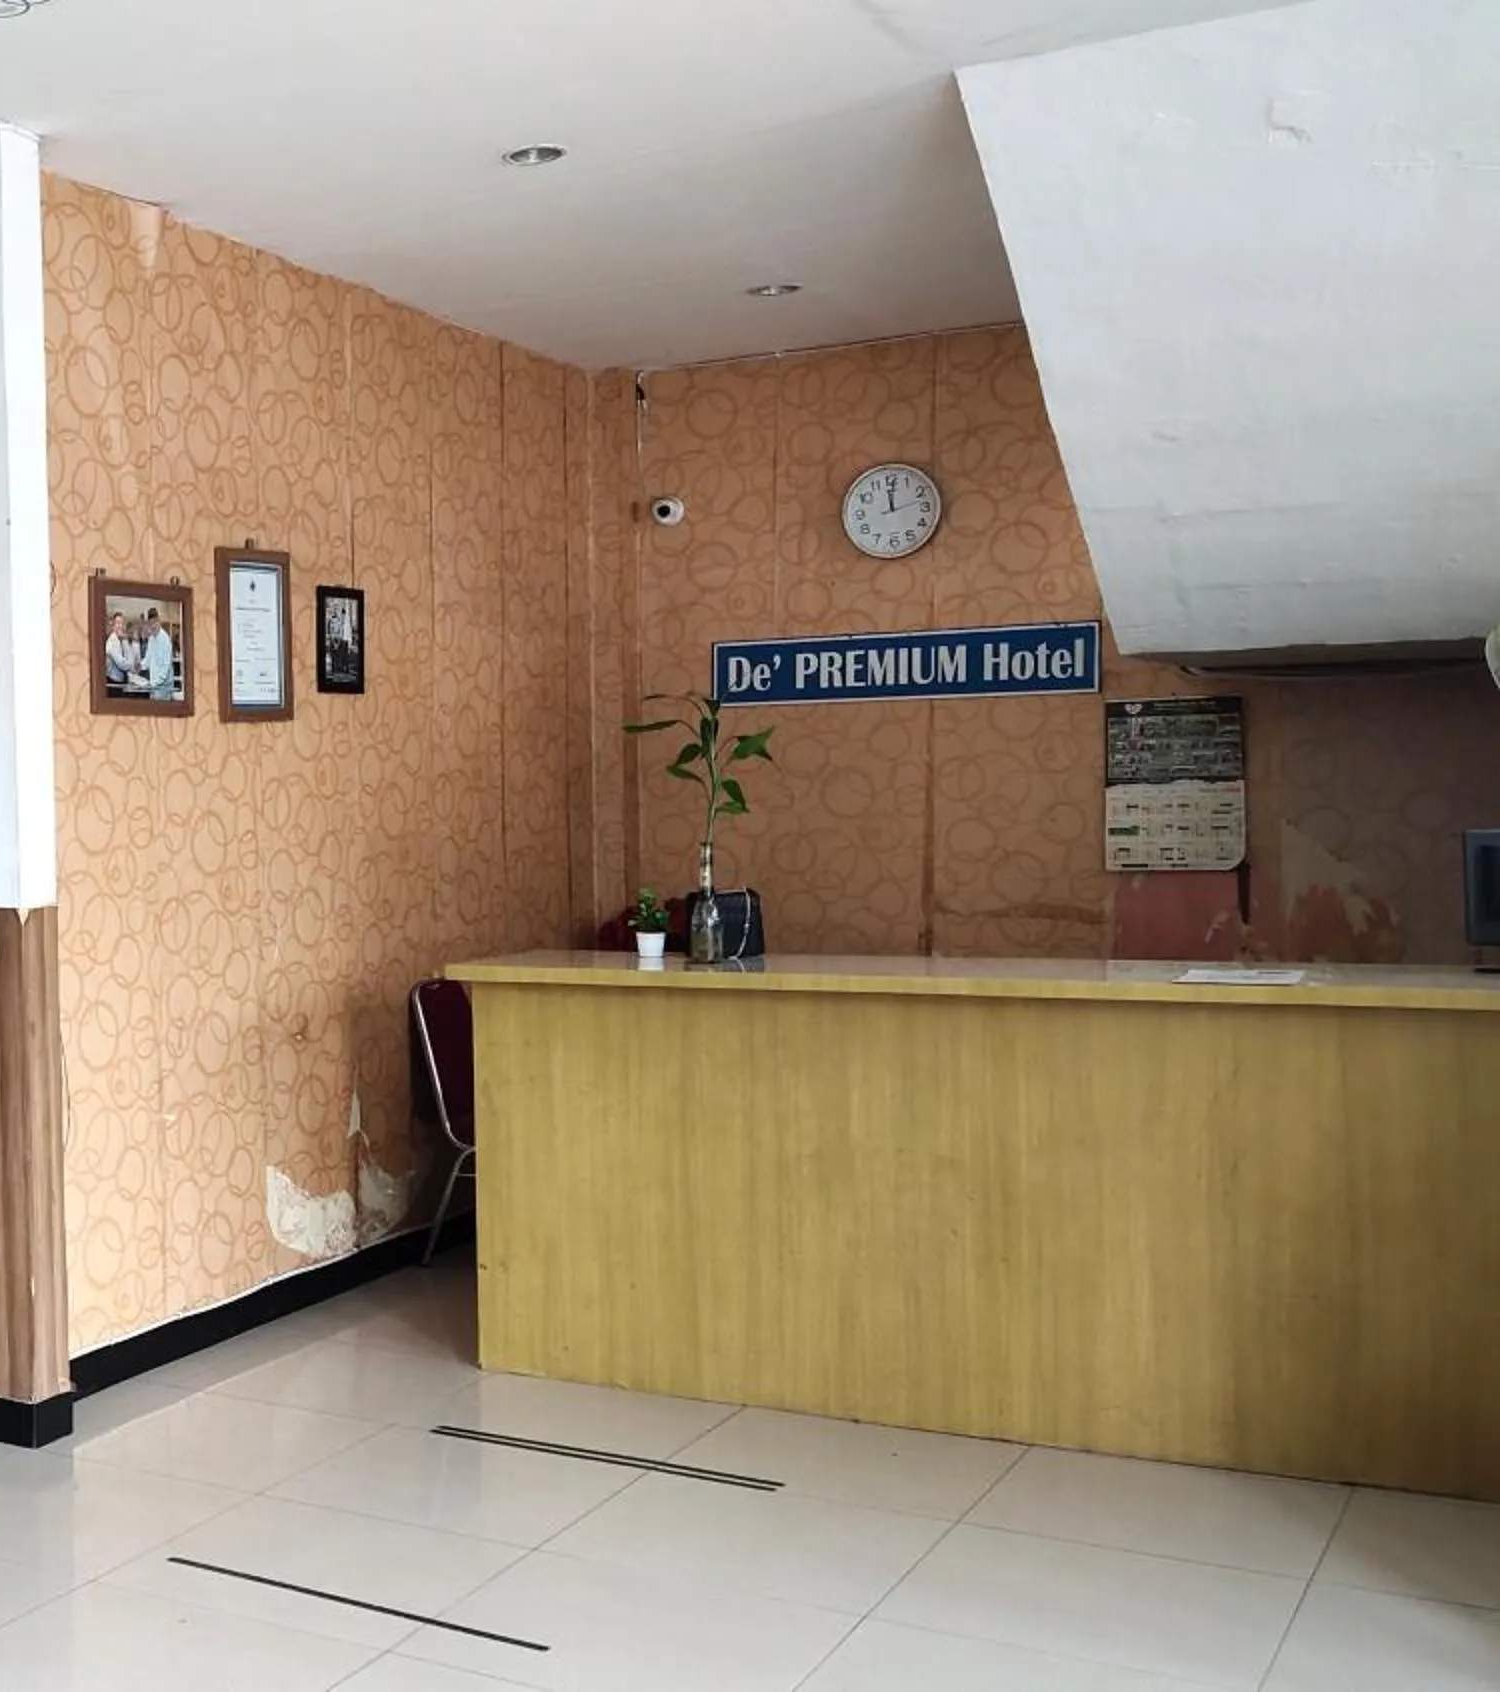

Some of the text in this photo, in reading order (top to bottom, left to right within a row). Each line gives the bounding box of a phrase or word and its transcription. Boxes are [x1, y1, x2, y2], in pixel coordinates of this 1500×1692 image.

[871, 480, 881, 491] 11
[915, 485, 925, 498] 2
[860, 491, 873, 504] 10
[920, 501, 931, 513] 3
[855, 508, 865, 520] 9
[917, 517, 927, 527] 4
[860, 523, 870, 534] 8
[871, 533, 881, 545] 7
[904, 529, 916, 541] 5
[889, 535, 901, 548] 6
[727, 637, 1085, 692] De' PREMIUM Hotel
